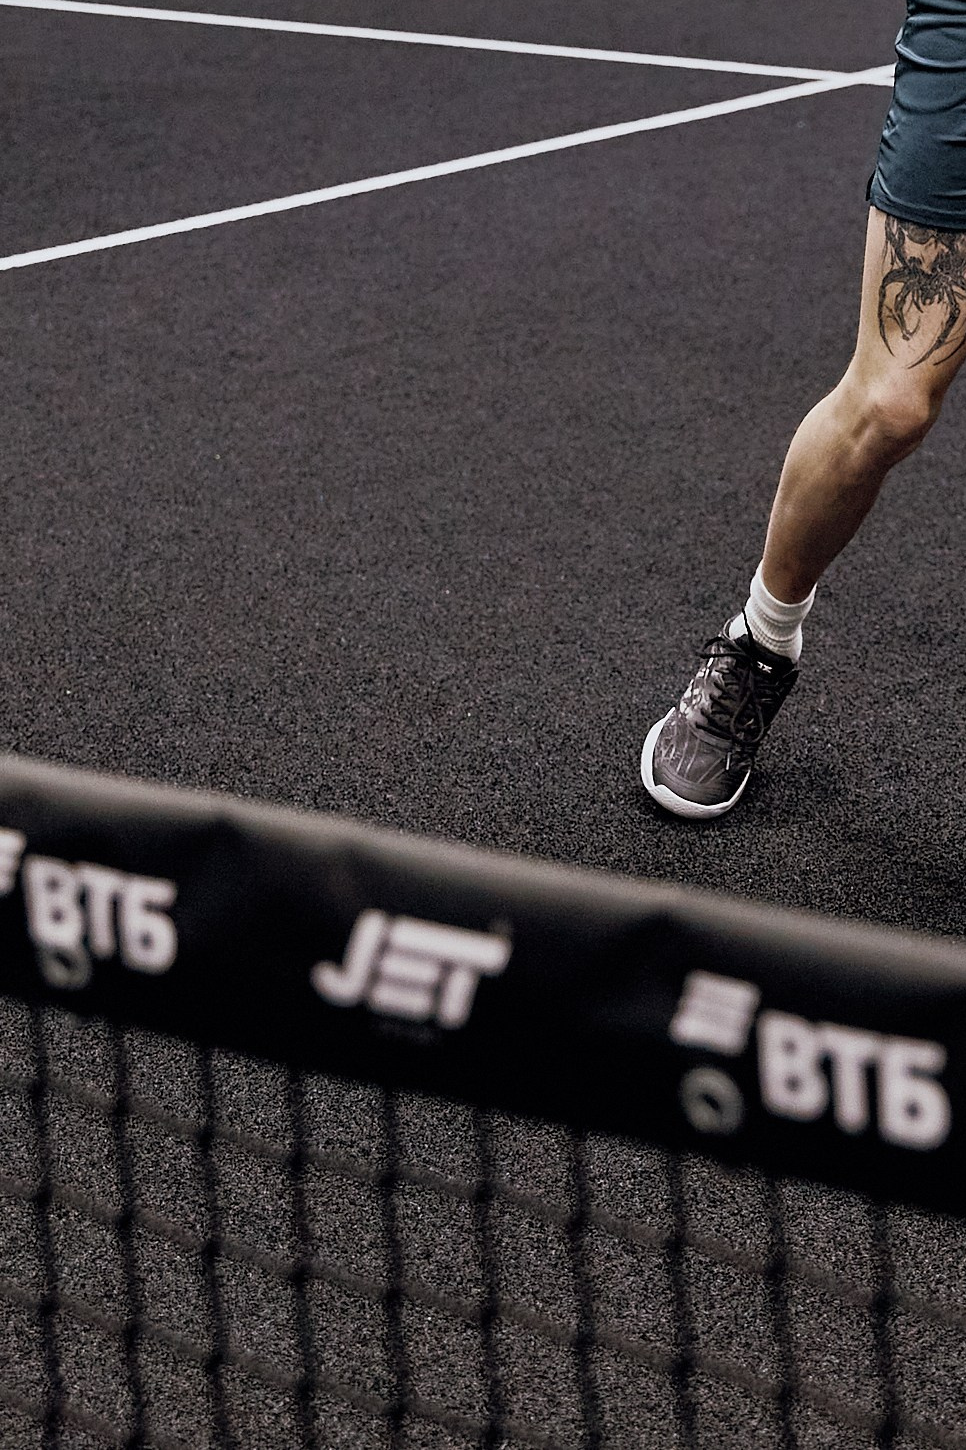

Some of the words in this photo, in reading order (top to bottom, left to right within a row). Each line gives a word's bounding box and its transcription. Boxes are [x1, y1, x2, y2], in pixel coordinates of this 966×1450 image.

[23, 855, 178, 975] ВТБ
[313, 908, 511, 1028] JET
[756, 1010, 951, 1148] ВТБ
